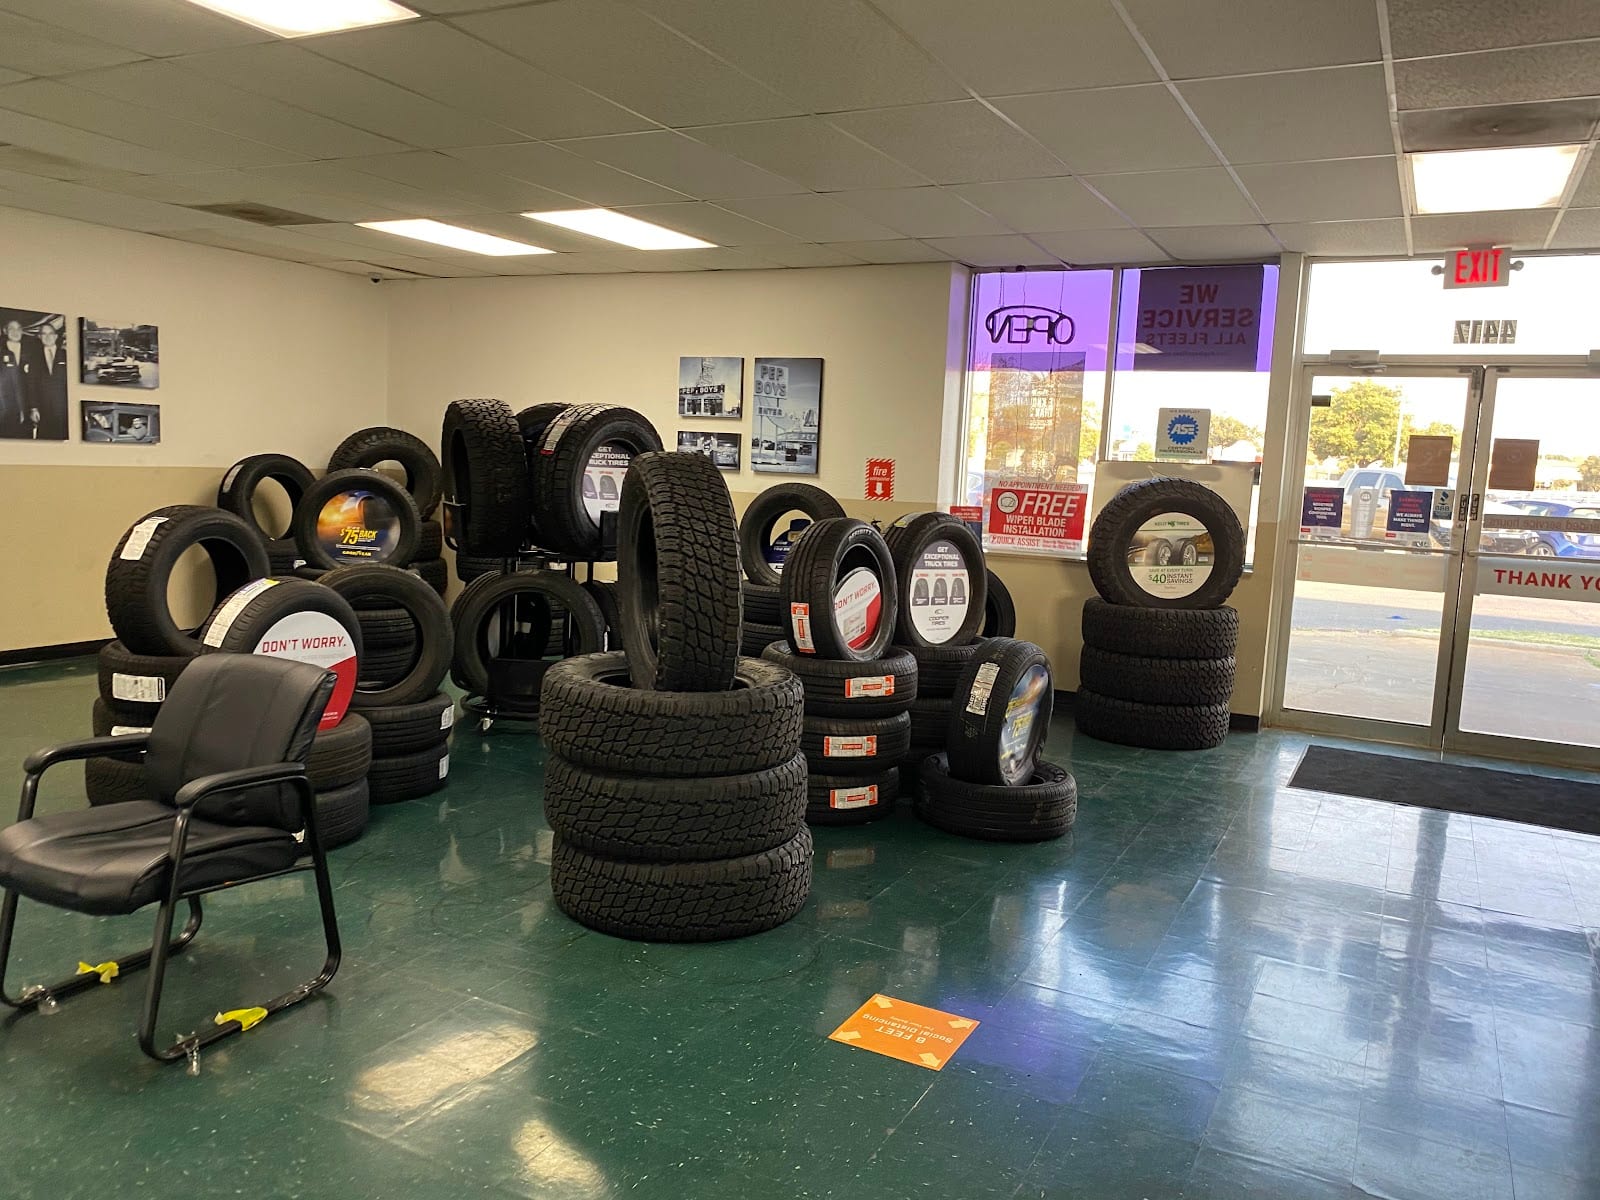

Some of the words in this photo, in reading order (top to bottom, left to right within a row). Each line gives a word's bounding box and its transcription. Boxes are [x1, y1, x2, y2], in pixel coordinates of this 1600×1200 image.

[1455, 249, 1504, 284] EXIT
[760, 366, 784, 381] PEP
[755, 380, 787, 397] BOYS
[1171, 423, 1195, 435] ASE
[592, 452, 631, 460] CEPTIONAL
[873, 466, 887, 476] fire
[999, 480, 1008, 488] NO
[1010, 482, 1054, 490] APPOINTMENT
[1020, 492, 1080, 517] FREE
[1006, 514, 1034, 525] WIPER
[1036, 517, 1066, 527] BLADE
[340, 528, 358, 544] $75
[359, 530, 378, 539] BACK
[996, 536, 1015, 545] QUICK
[1017, 537, 1040, 547] ASSIST
[1149, 573, 1167, 584] $40
[1493, 569, 1572, 589] THANK
[834, 593, 853, 609] DON'T
[262, 639, 299, 653] DON'T
[302, 636, 346, 649] WORRY.
[862, 1013, 918, 1034] Distancing
[875, 1026, 913, 1040] FEET
[920, 1030, 953, 1044] Social
